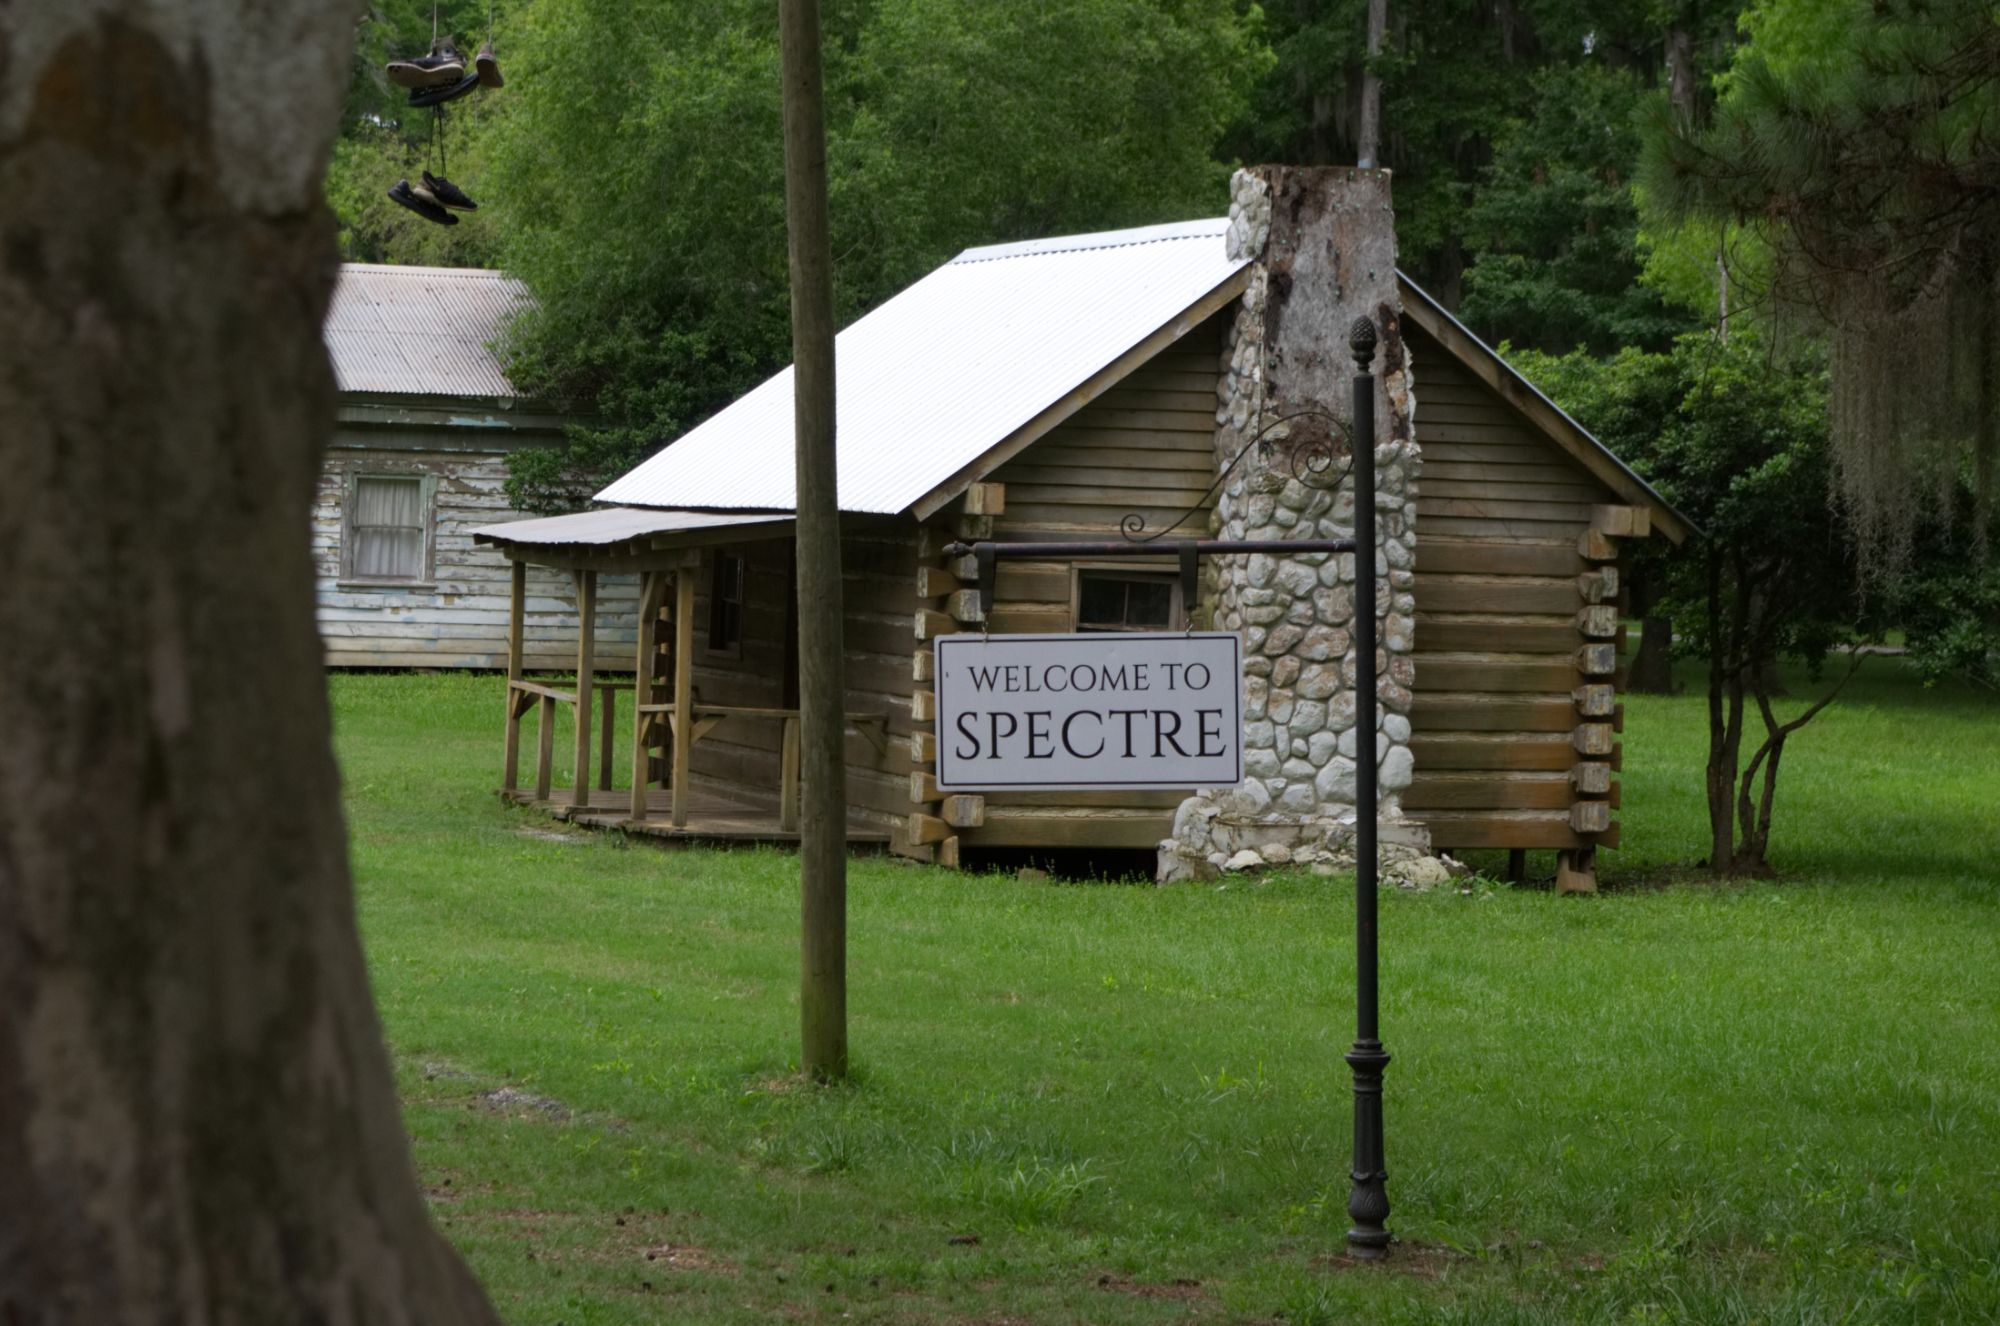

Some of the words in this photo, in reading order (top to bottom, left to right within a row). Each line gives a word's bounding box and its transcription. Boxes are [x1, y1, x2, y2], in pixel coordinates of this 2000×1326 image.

[967, 663, 1150, 692] WELCOME
[1160, 662, 1211, 691] TO
[955, 708, 1227, 760] SPECTRE
